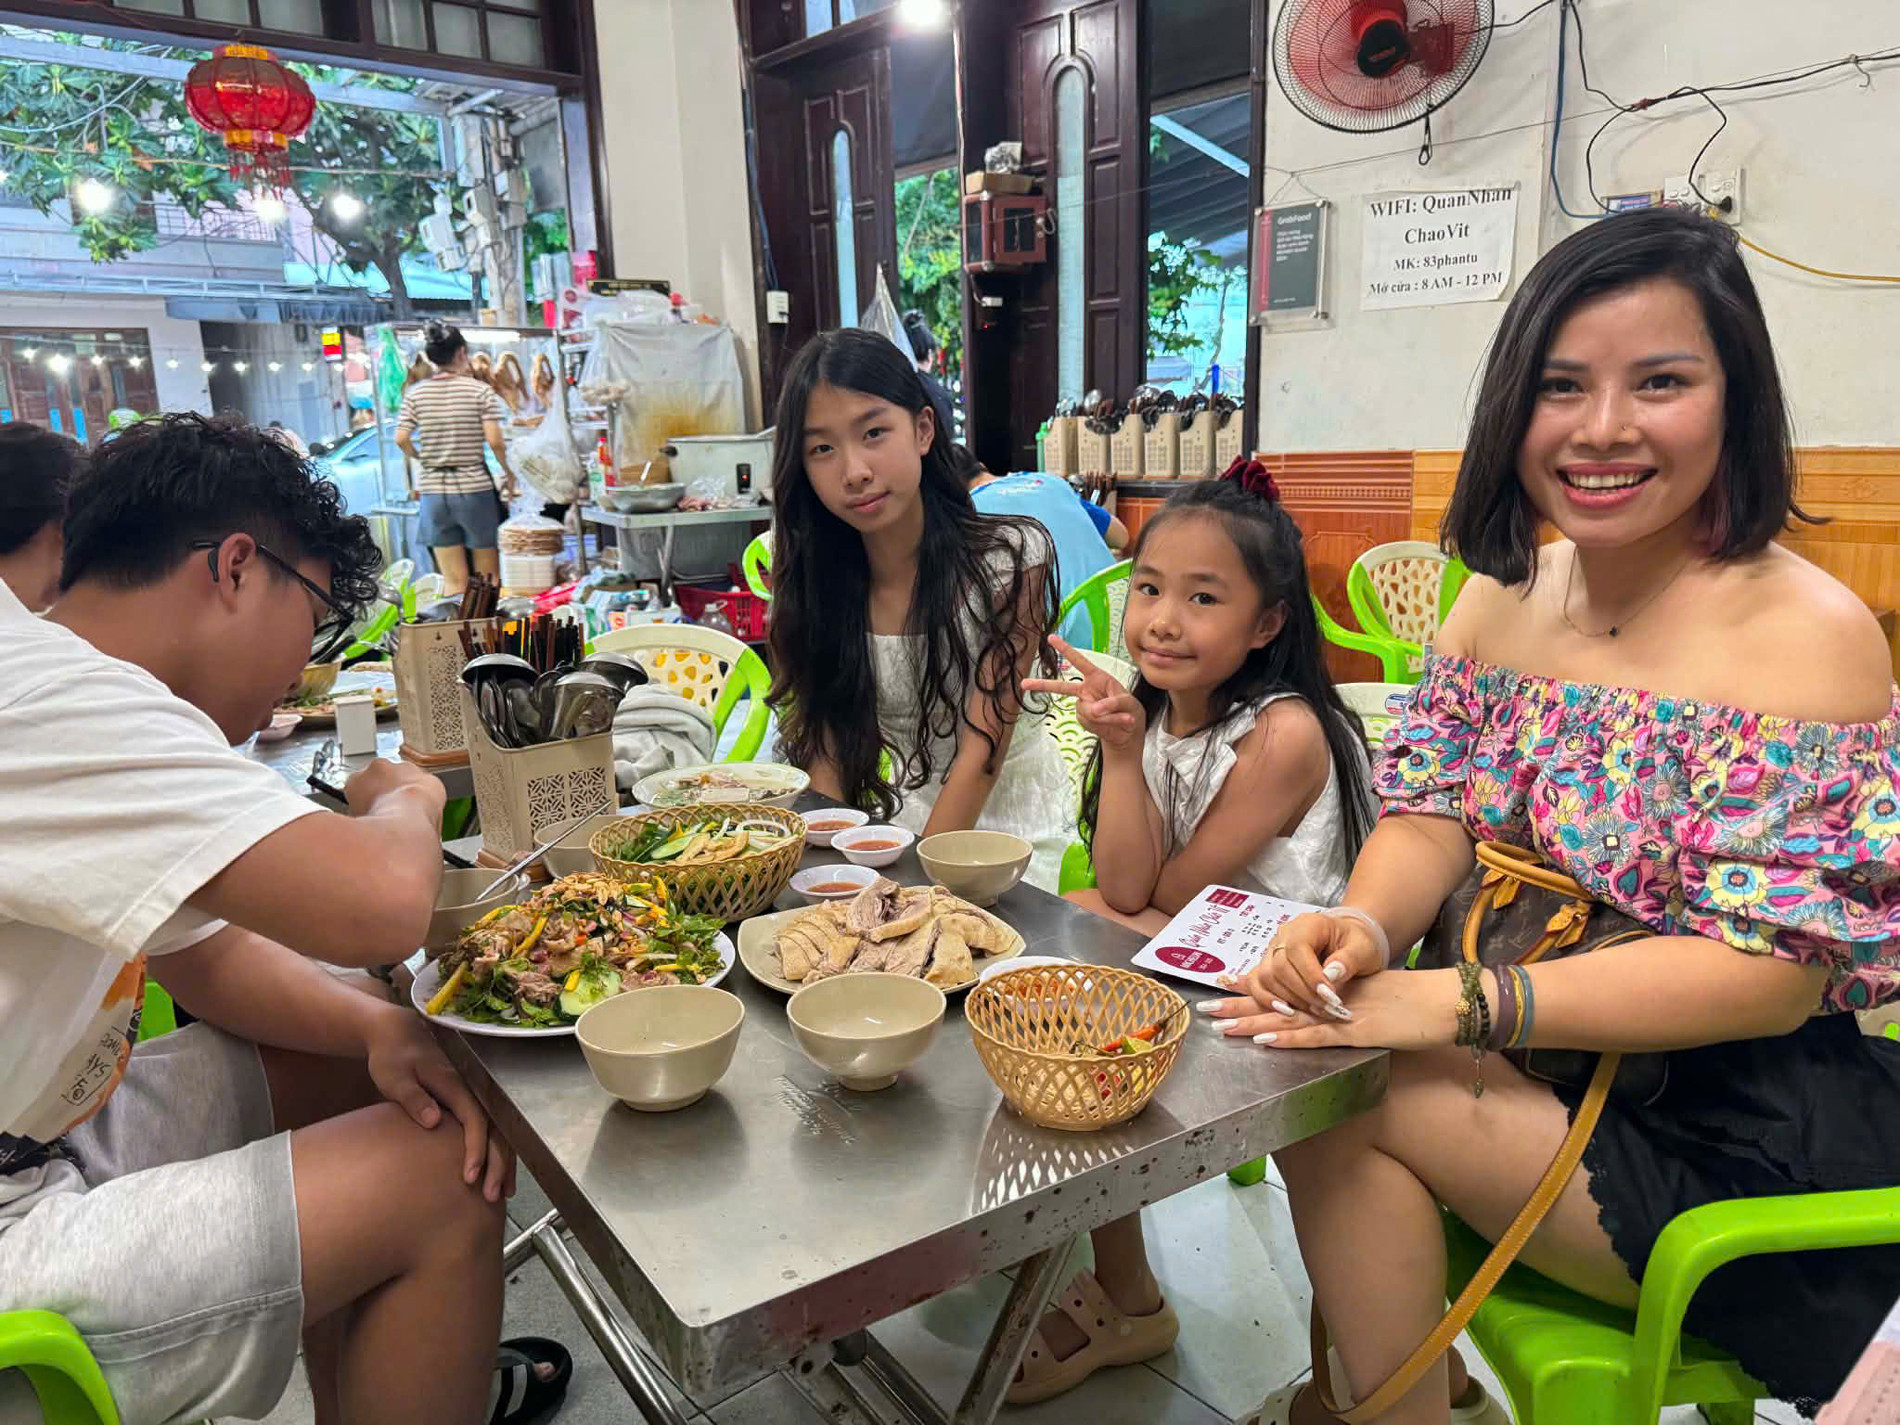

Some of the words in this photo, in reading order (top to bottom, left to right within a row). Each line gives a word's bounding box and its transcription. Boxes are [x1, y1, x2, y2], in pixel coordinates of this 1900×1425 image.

[1370, 198, 1417, 218] WIFI:
[1277, 212, 1312, 225] GrabFood
[1393, 257, 1420, 271] MK:
[1423, 253, 1478, 269] 83phantu
[1465, 274, 1479, 286] 12
[1482, 271, 1502, 285] PM
